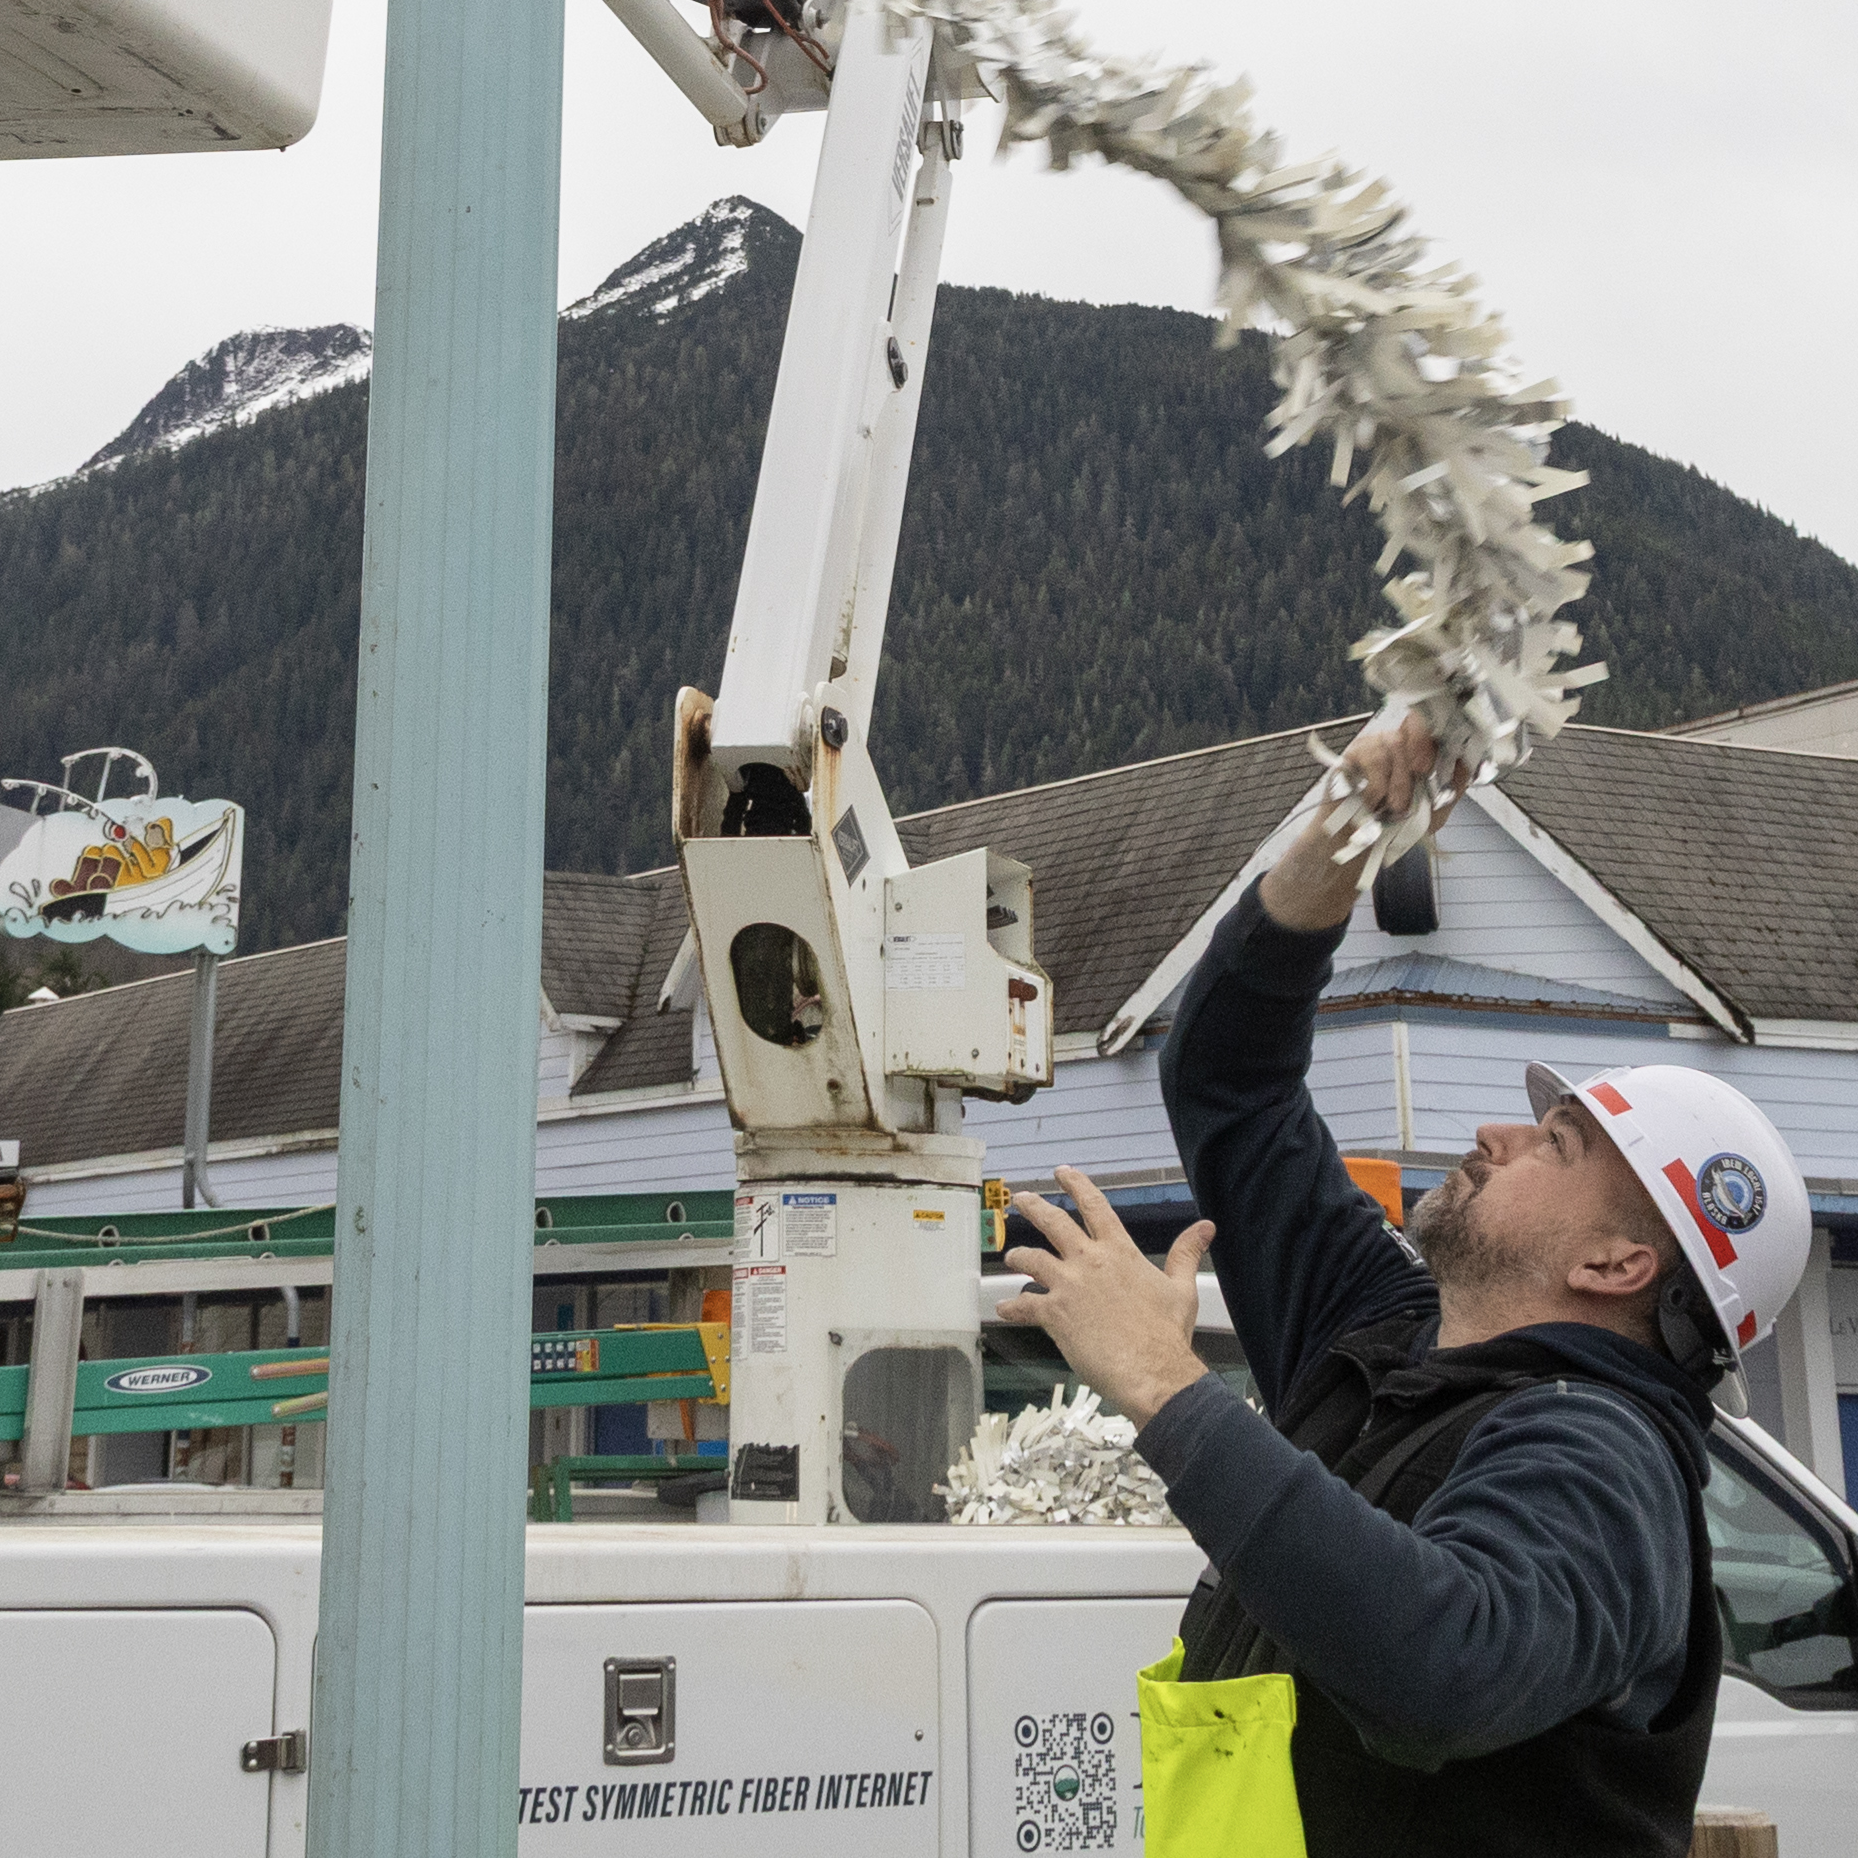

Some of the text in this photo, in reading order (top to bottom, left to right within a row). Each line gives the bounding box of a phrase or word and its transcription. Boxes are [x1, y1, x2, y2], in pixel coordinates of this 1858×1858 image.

[892, 64, 921, 204] VERSALIFT
[1720, 1158, 1742, 1172] IBEW
[1742, 1165, 1762, 1192] LOCAL
[797, 1196, 830, 1204] NOTICE
[1702, 1191, 1728, 1226] ALASKA
[126, 1368, 198, 1387] WERNER
[518, 1771, 934, 1825] TEST SYMMETRIC FIBER INTERNET
